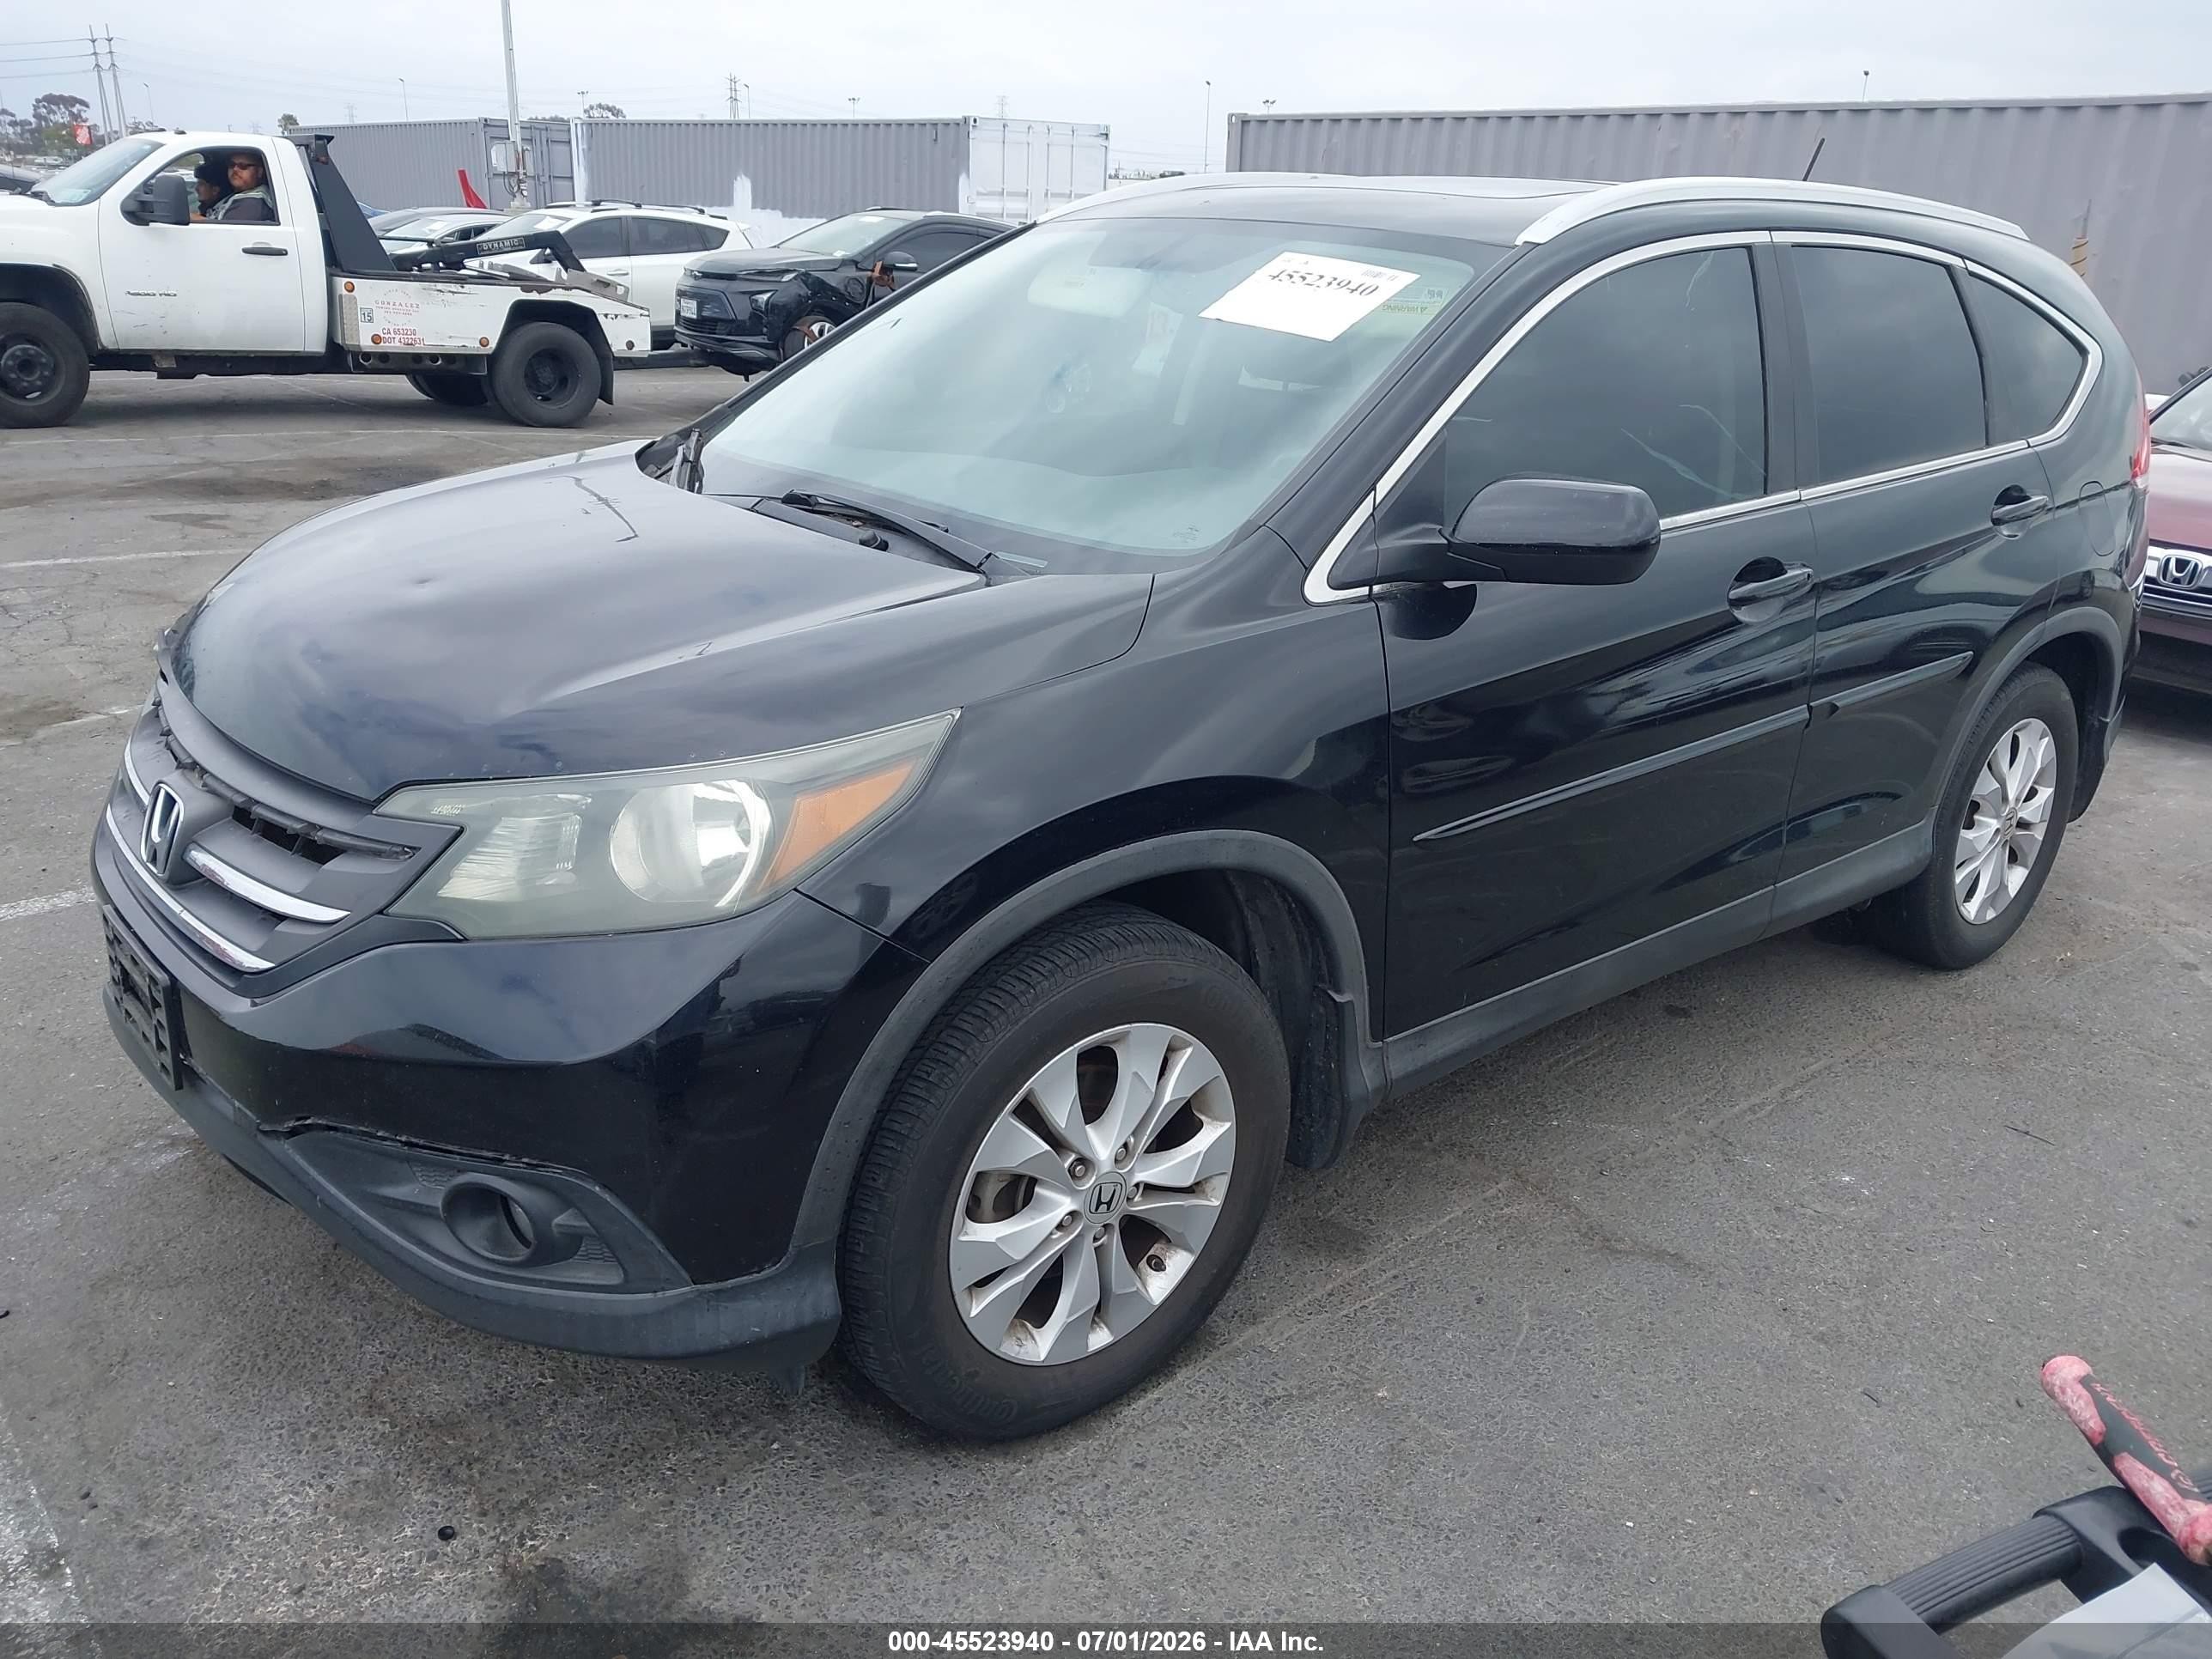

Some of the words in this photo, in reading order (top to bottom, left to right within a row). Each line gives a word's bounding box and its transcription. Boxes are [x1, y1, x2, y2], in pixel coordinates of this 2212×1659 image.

[483, 240, 520, 250] DYNAMIC
[1268, 269, 1379, 296] 45523940
[374, 300, 419, 308] GONZALEZ
[362, 312, 372, 322] 15
[382, 336, 396, 344] DOT
[398, 337, 426, 346] 4322631
